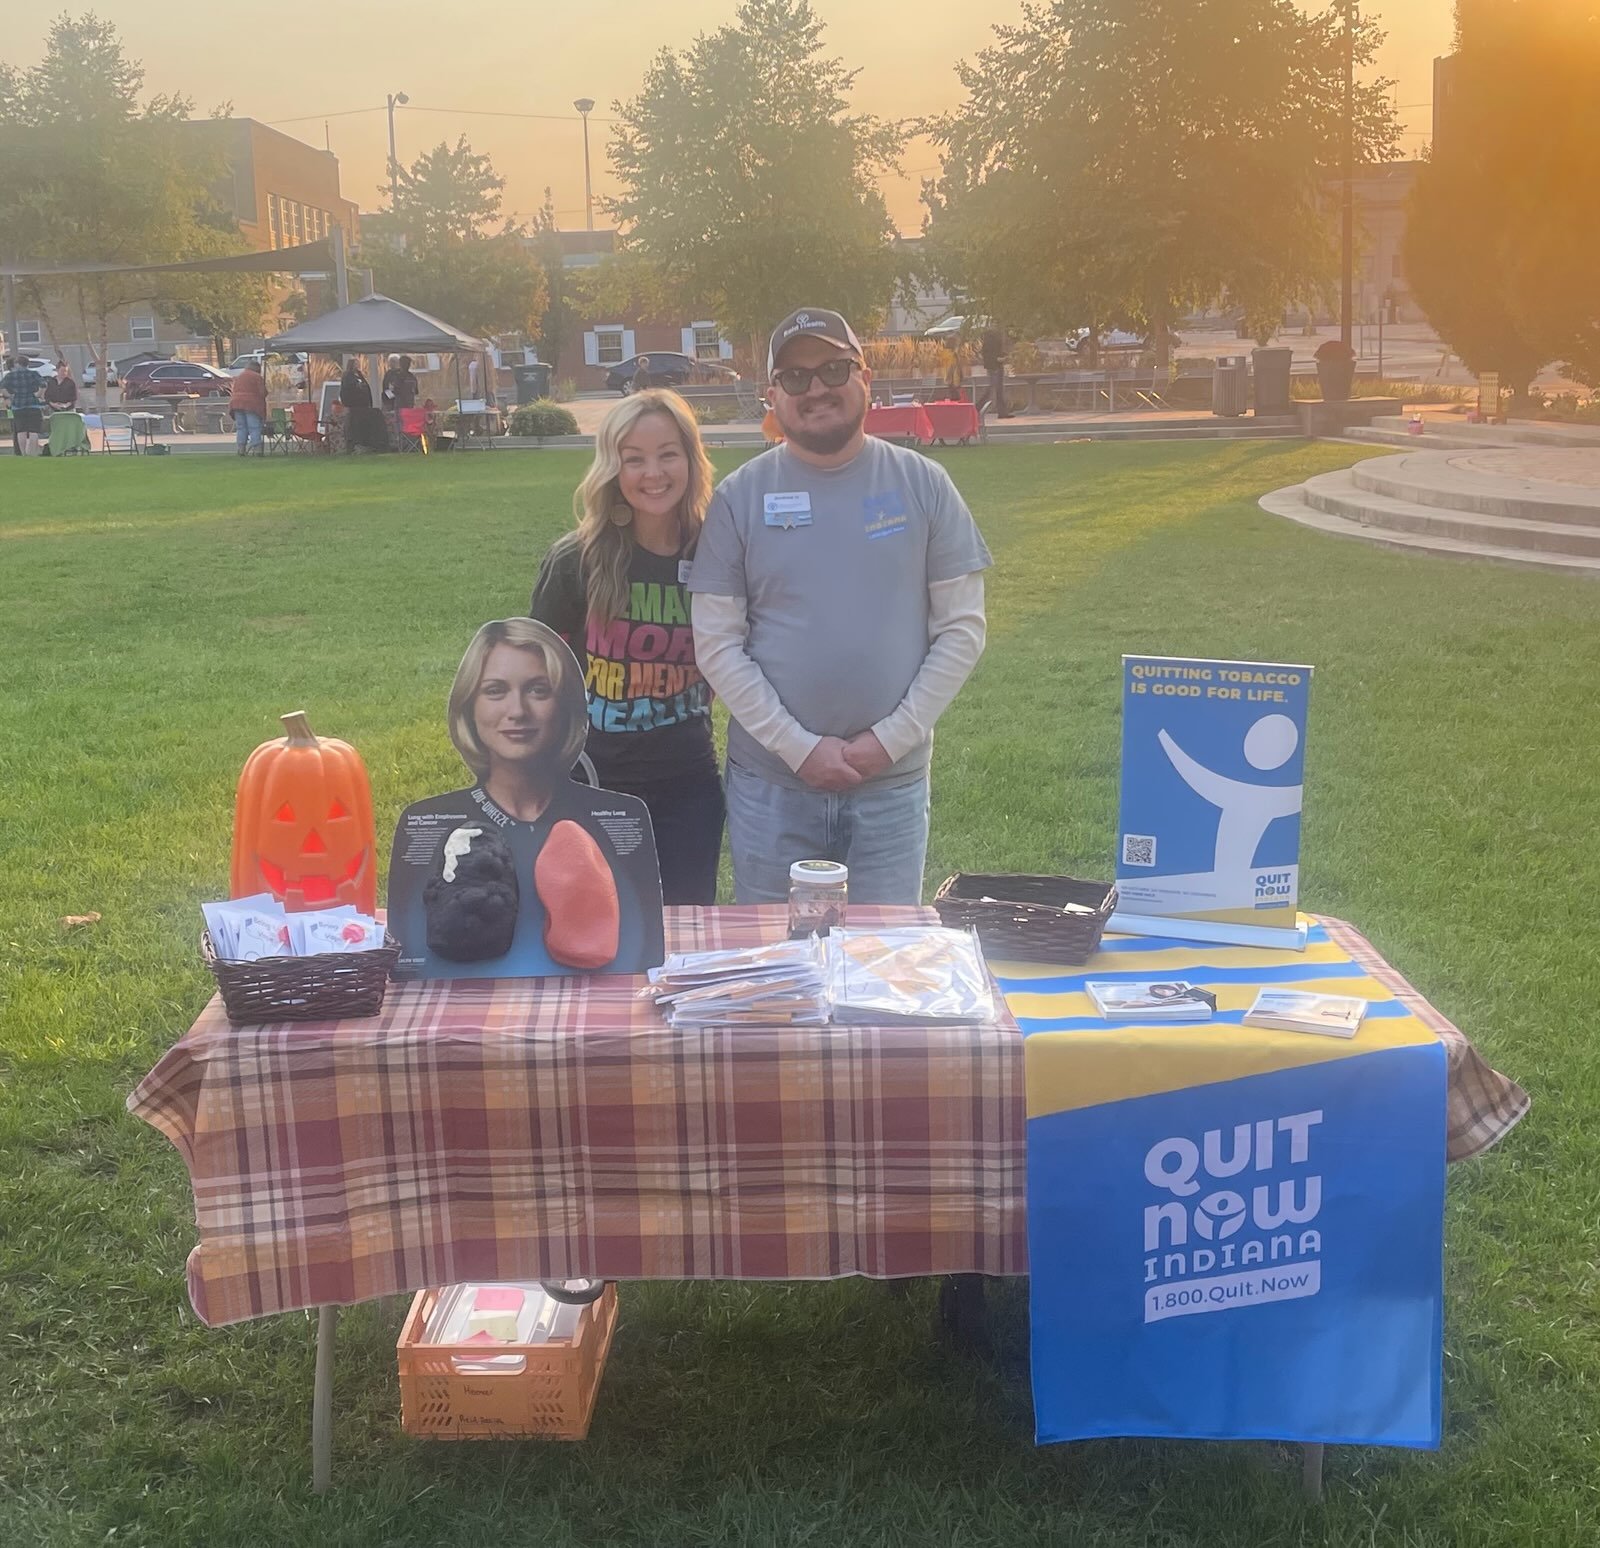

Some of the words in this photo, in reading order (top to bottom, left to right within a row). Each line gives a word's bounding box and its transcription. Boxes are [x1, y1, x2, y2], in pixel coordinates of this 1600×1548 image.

[587, 653, 625, 700] FOR
[1132, 665, 1212, 680] QUITTING
[1218, 670, 1301, 685] TOBACCO
[1131, 682, 1147, 694] IS
[1152, 684, 1201, 697] GOOD
[1207, 686, 1241, 700] FOR
[1248, 689, 1288, 703] LIFE.
[1256, 873, 1291, 887] QUIT
[1144, 1109, 1324, 1197] QUIT
[1152, 1274, 1309, 1311] 1.800.Quit.Now
